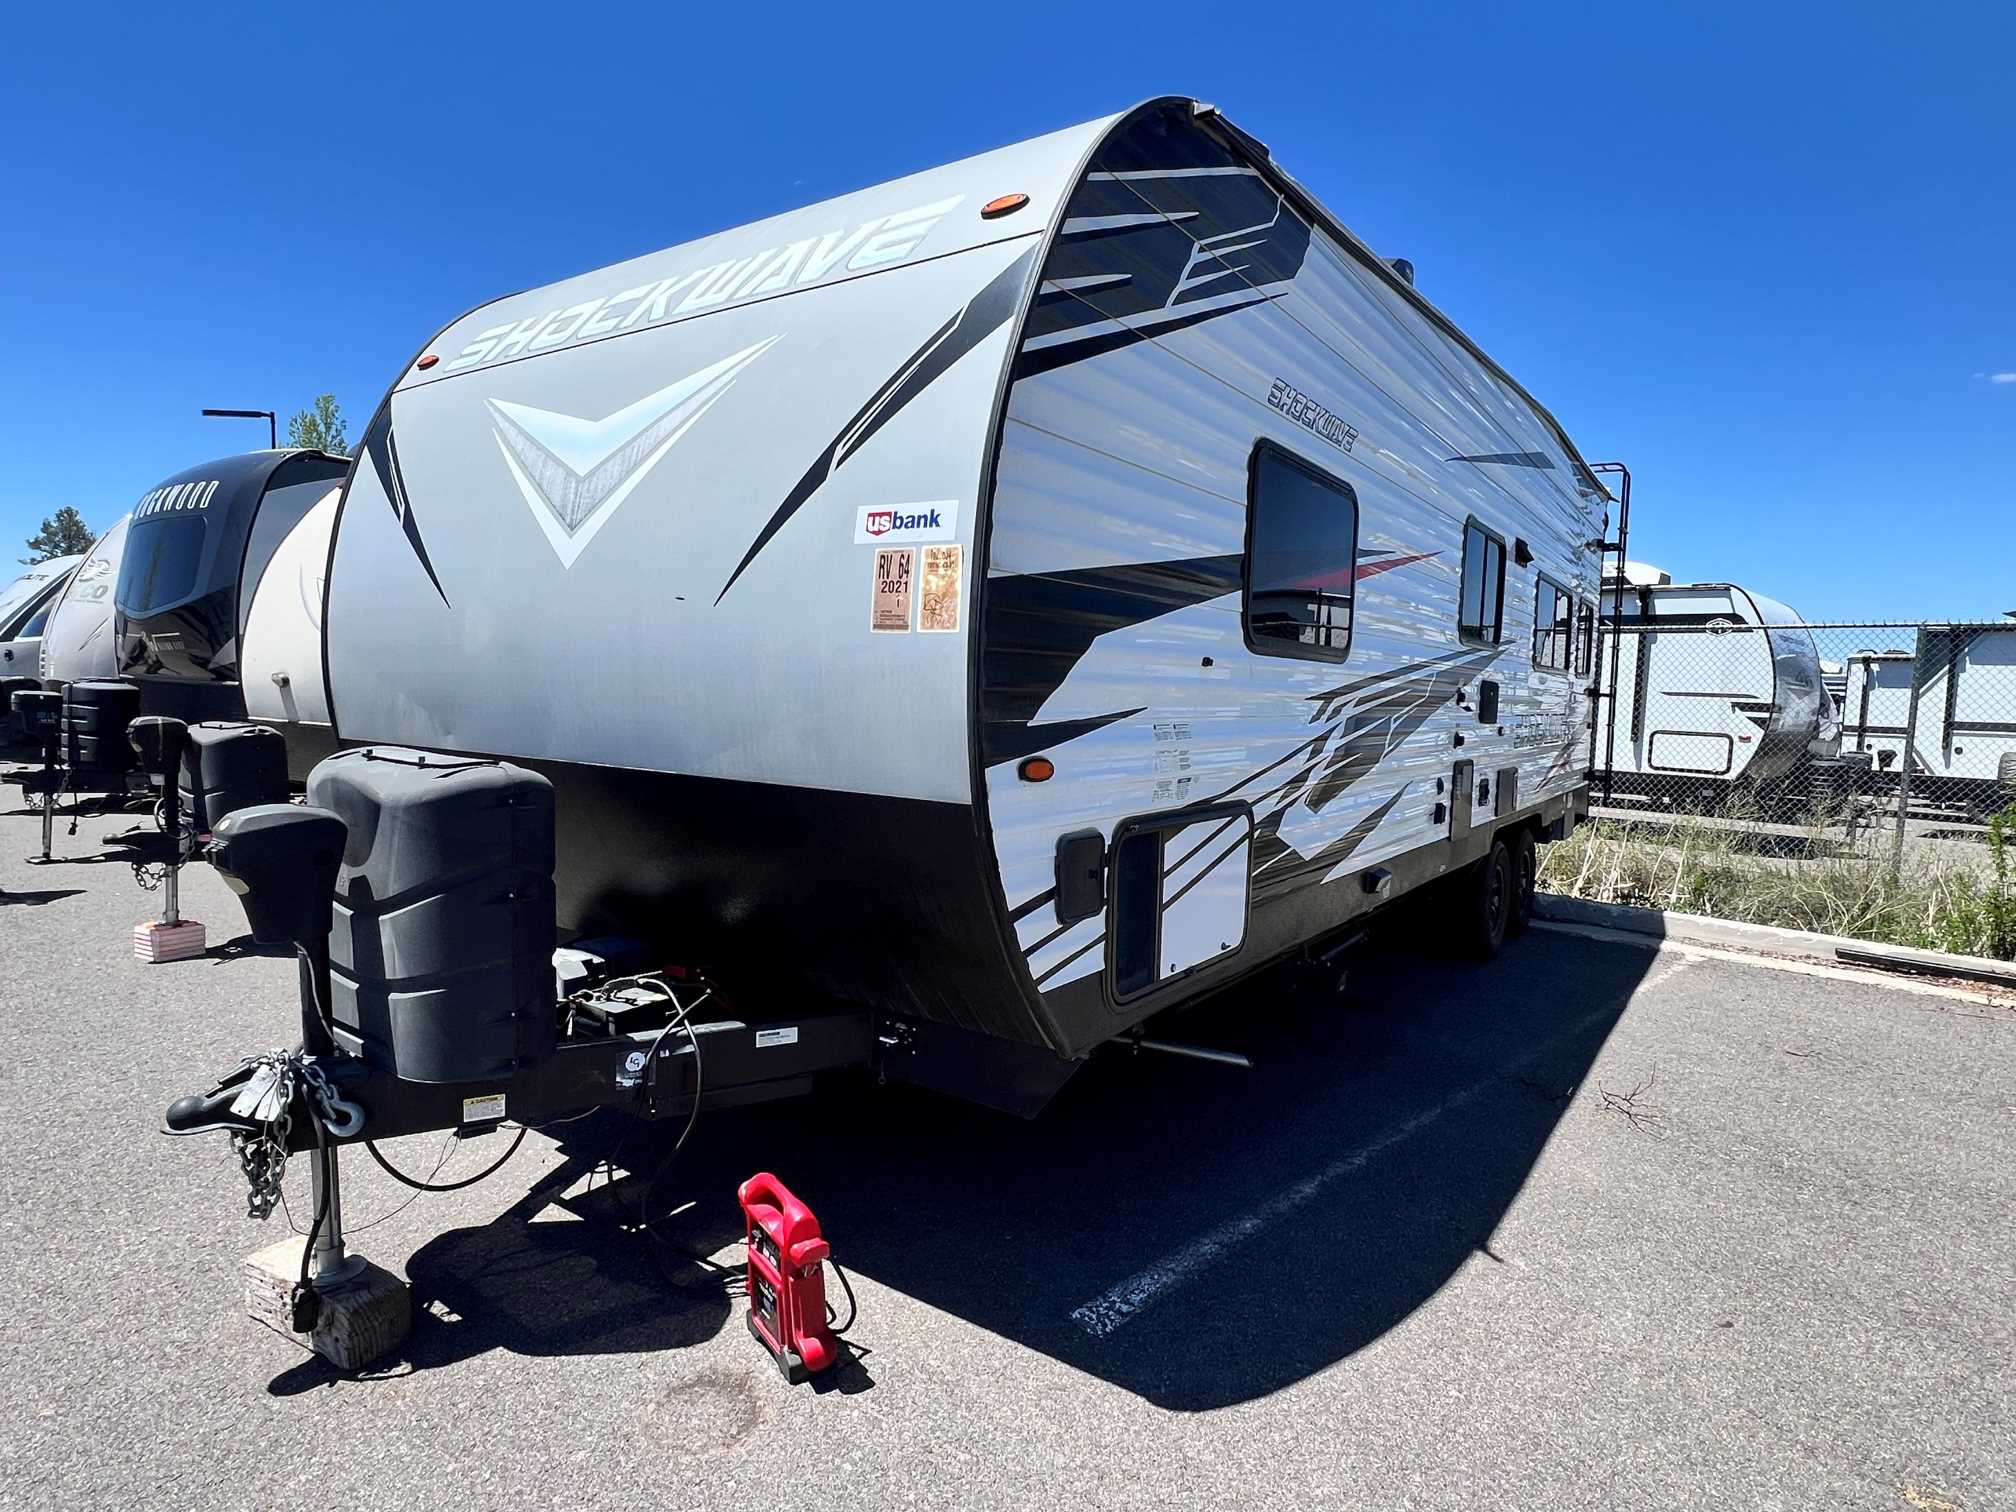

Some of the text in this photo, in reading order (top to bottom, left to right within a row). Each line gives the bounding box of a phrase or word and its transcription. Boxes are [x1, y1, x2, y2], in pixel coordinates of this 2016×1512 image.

[444, 195, 965, 373] SHOCKWAVE
[1268, 377, 1359, 453] SHOCKWAVE
[878, 554, 893, 580] RV
[898, 553, 911, 580] 64
[880, 580, 909, 594] 2021
